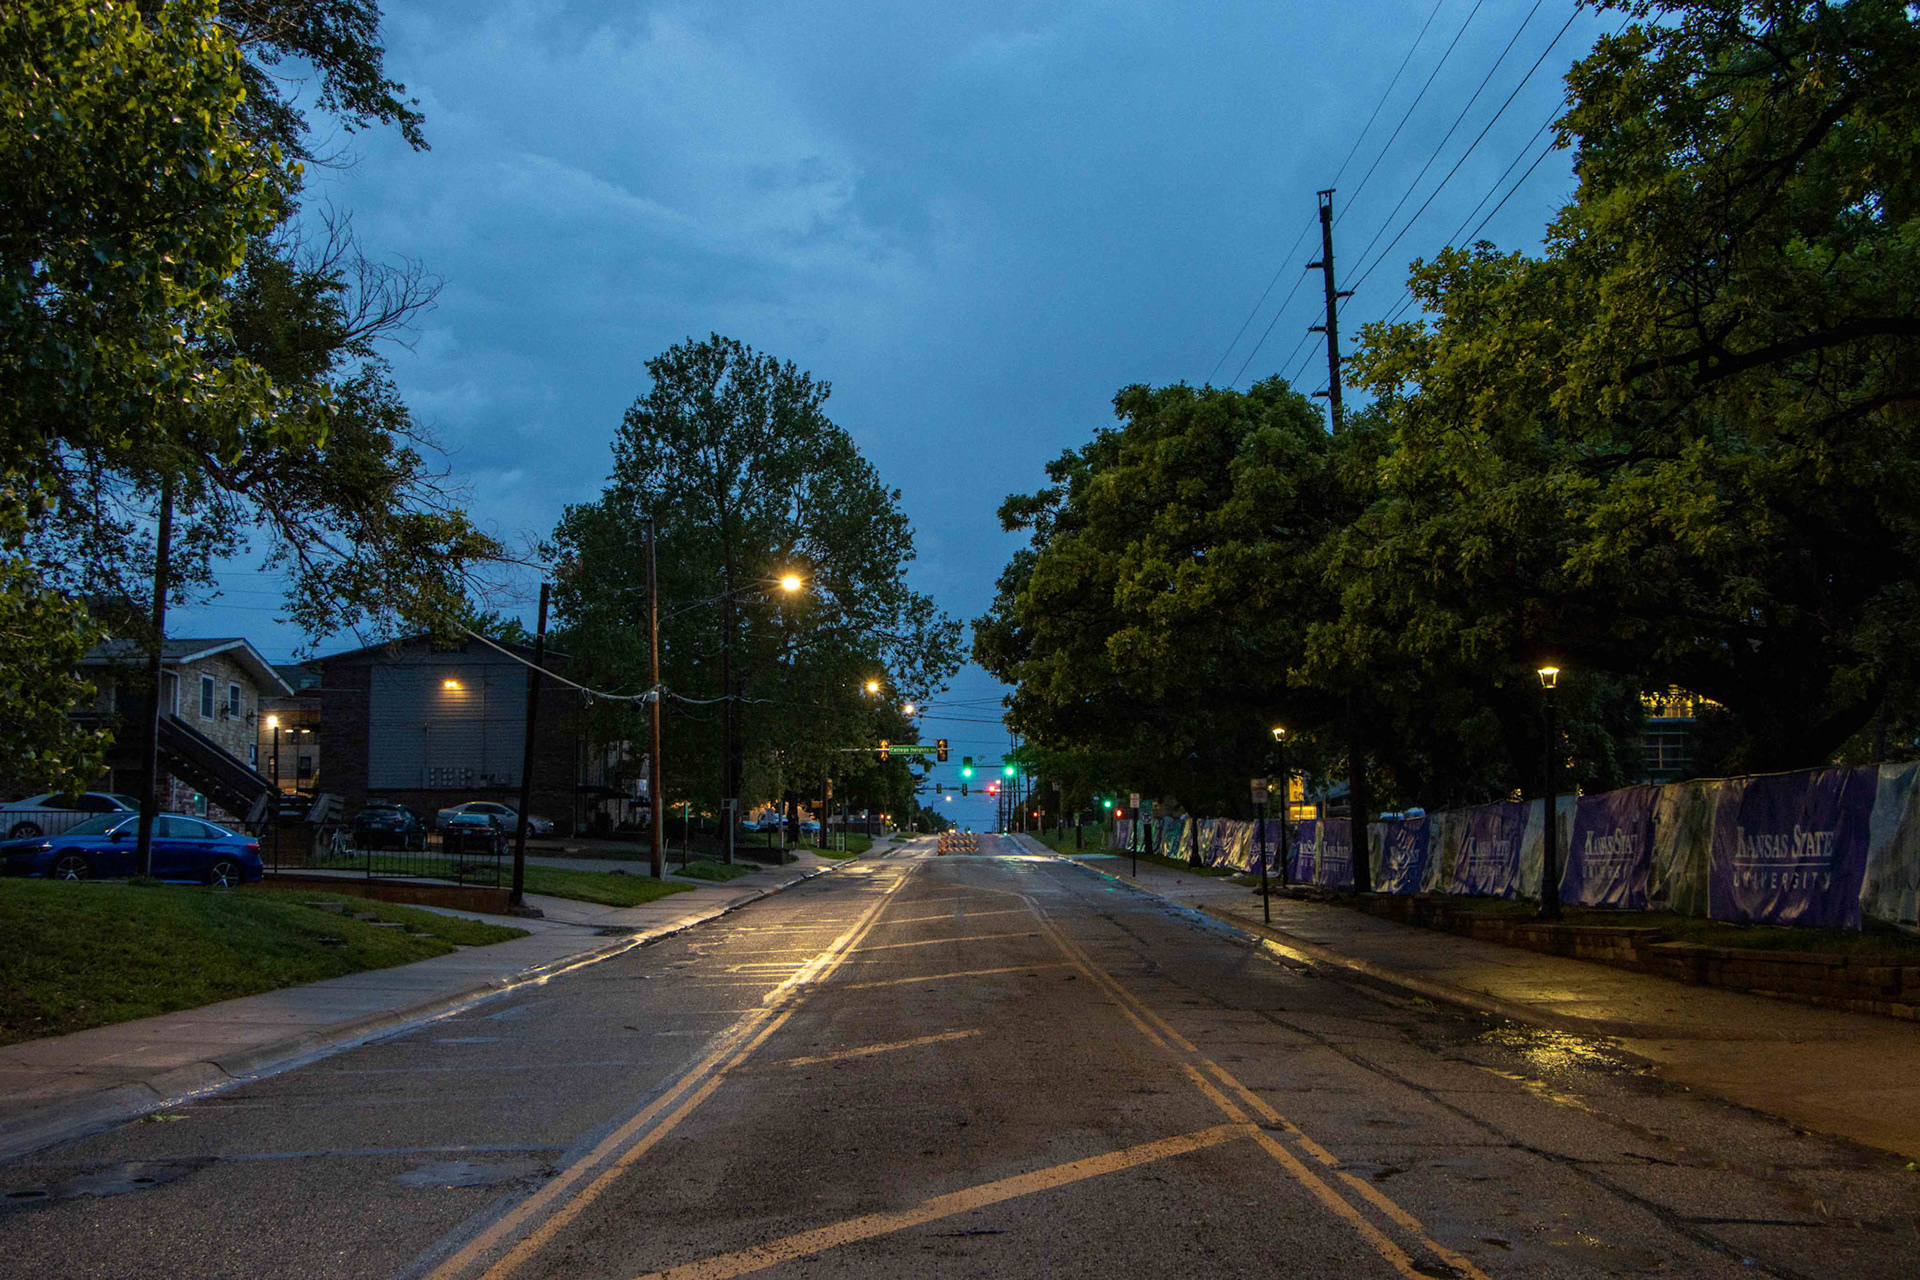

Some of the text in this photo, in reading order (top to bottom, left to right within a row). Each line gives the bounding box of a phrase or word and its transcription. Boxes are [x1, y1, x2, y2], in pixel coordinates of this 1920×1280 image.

[1735, 824, 1834, 859] KANSAS STATE
[1733, 871, 1831, 891] UNIVERSITY
